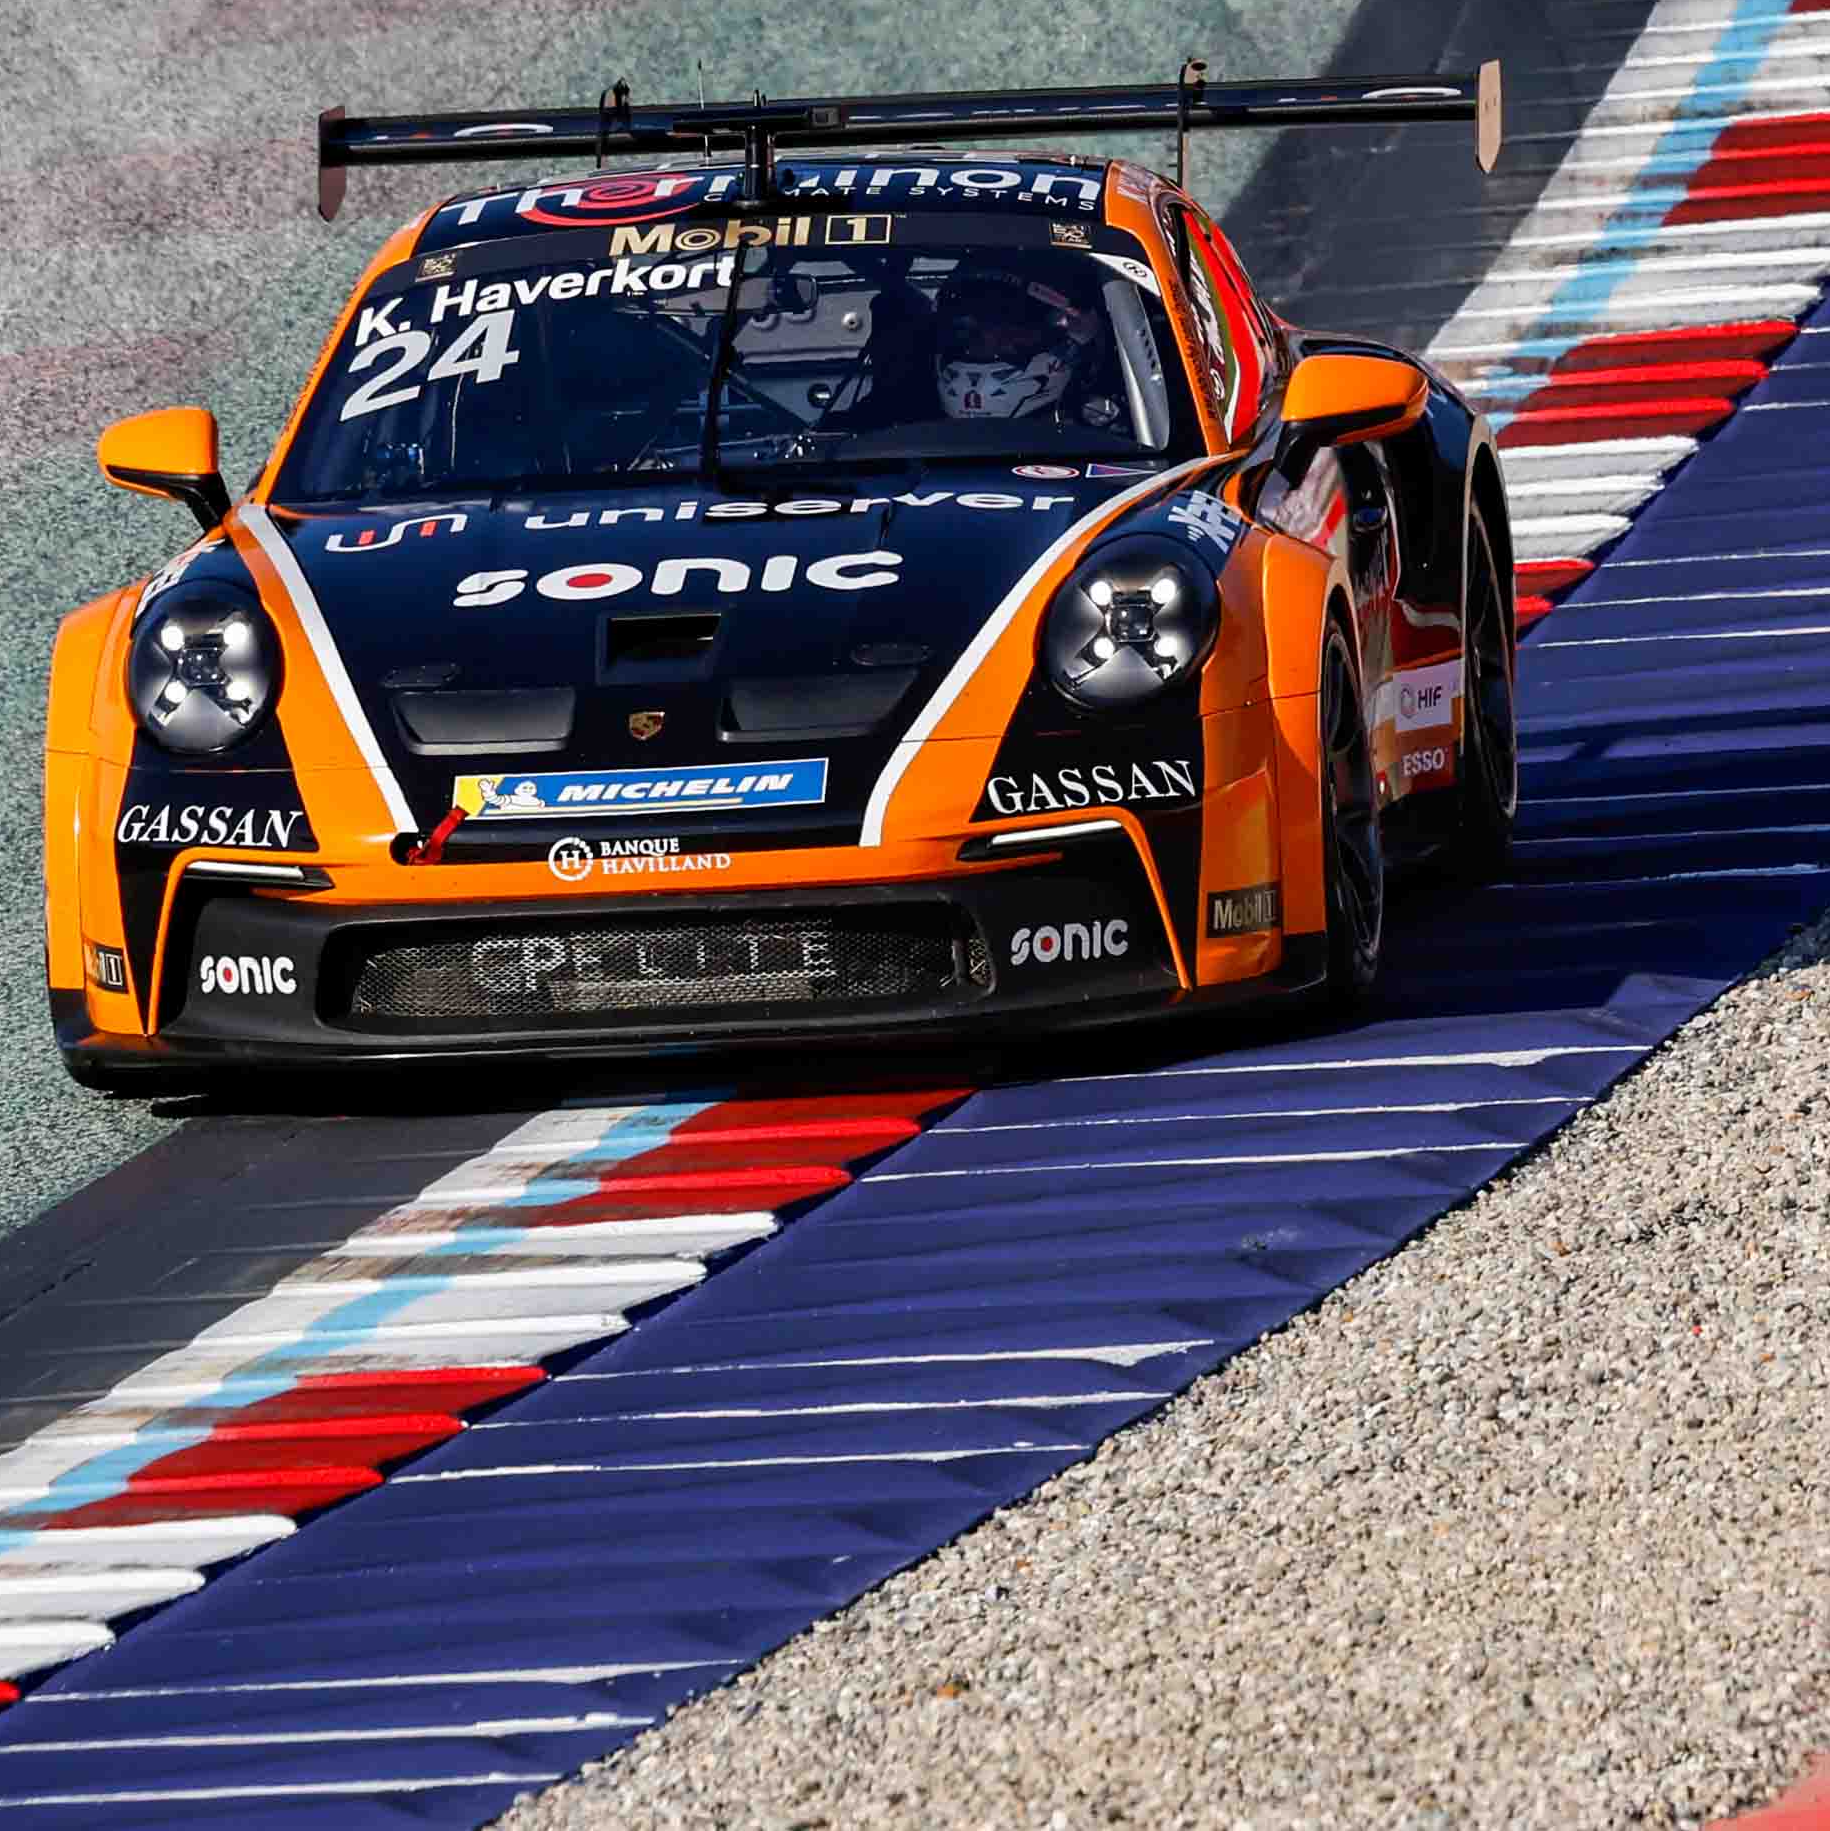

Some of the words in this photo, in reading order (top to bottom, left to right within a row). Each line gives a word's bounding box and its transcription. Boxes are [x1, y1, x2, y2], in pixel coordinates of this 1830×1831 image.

[908, 186, 1095, 211] SYSTEMS
[609, 217, 811, 258] Mobil
[355, 296, 411, 347] K.
[430, 256, 736, 323] Haverkort
[340, 309, 519, 422] 24
[525, 492, 1075, 529] uniserver
[1417, 685, 1443, 710] HIF
[1401, 747, 1446, 777] ESSO
[556, 772, 794, 803] MICHELIN
[987, 759, 1197, 815] GASSAN
[118, 804, 304, 848] GASSAN
[600, 837, 680, 857] BANQUE
[601, 852, 731, 876] HAVILLAND
